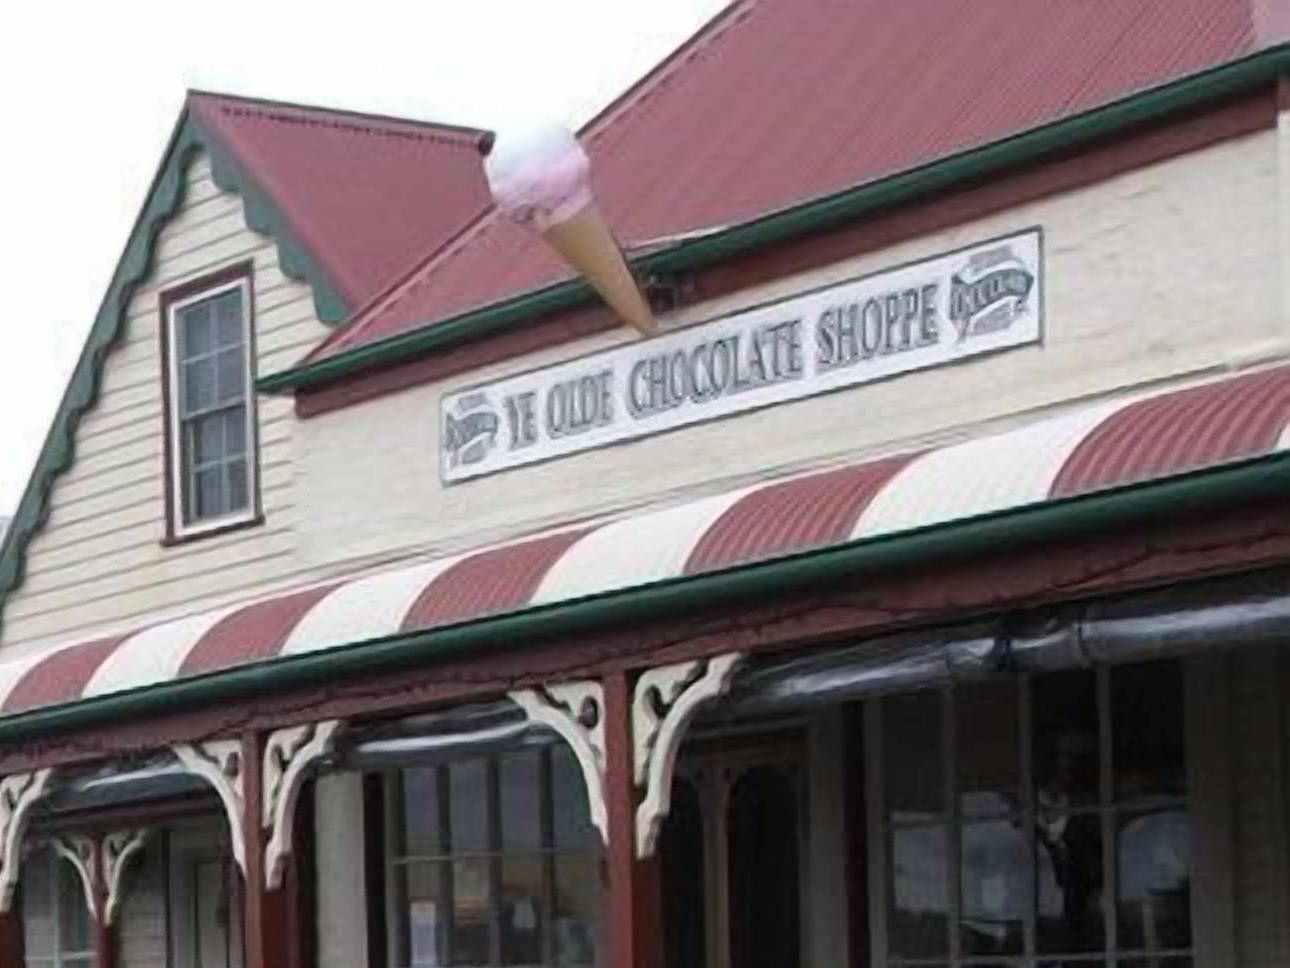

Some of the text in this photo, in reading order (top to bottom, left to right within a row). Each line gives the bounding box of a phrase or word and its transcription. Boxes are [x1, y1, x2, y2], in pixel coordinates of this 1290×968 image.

[504, 390, 537, 449] YE
[546, 366, 612, 439] OLDE
[627, 318, 803, 418] CHOCOLATE
[815, 284, 938, 370] SHOPPE
